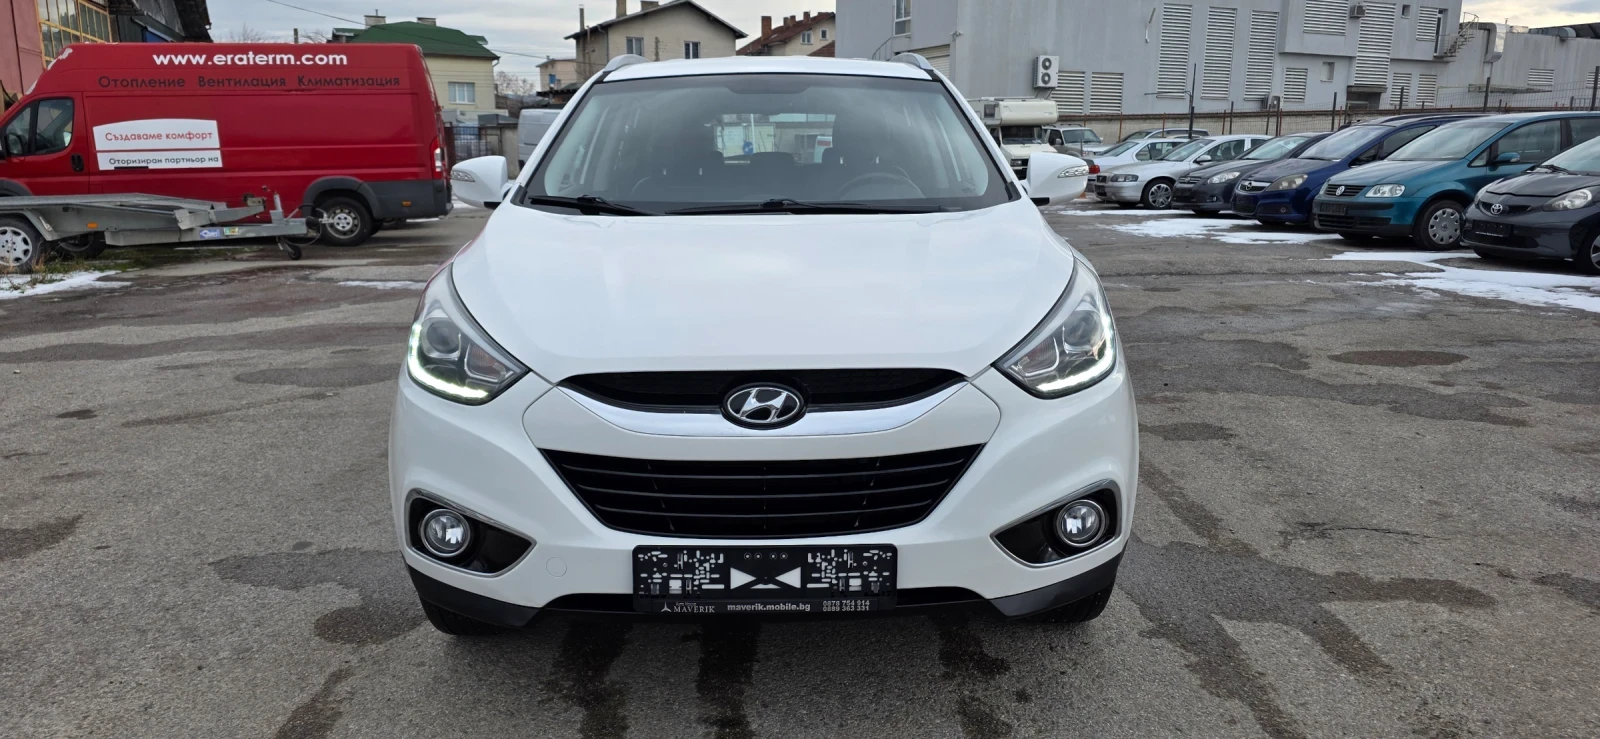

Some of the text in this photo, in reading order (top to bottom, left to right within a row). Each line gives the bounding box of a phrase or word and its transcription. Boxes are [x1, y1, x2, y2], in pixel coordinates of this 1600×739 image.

[152, 51, 348, 66] www.eraterm.com
[98, 75, 400, 89] Отопление Вентилация Климатизация
[105, 130, 213, 142] Създаваме комфорт
[108, 156, 219, 167] Оторизиран партньор на
[673, 605, 715, 613] MAVERIK
[727, 603, 811, 611] maverik.mobile.bg
